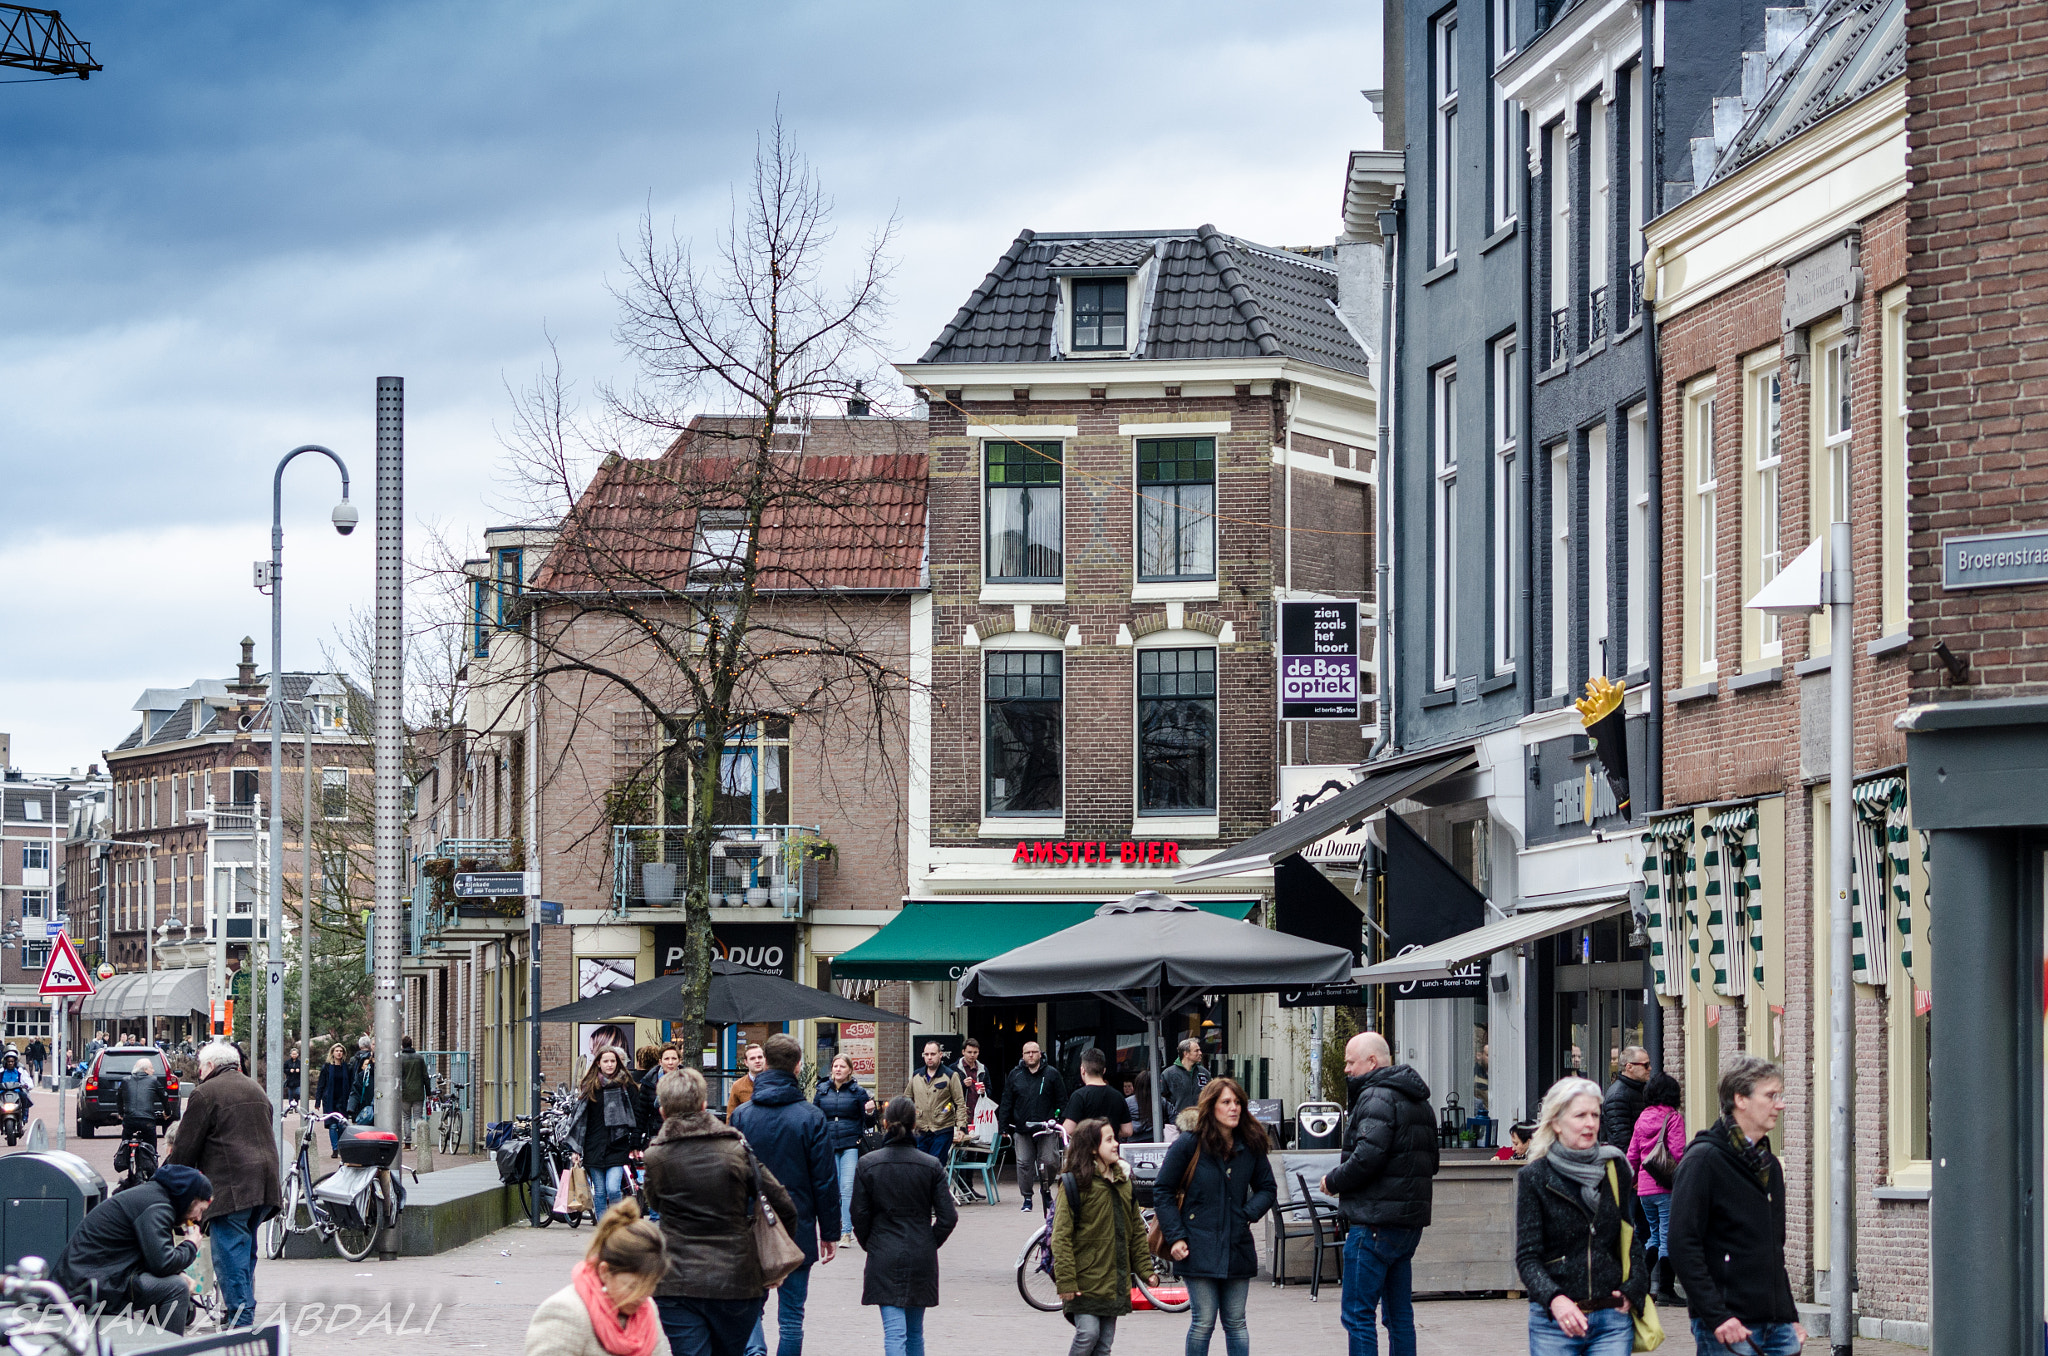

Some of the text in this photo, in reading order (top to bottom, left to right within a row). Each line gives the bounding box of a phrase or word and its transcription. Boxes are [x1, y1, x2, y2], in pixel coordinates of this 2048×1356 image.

[1314, 607, 1340, 618] zien
[1314, 619, 1347, 630] zoals
[1314, 630, 1335, 641] het
[1314, 642, 1349, 653] hoort
[1287, 659, 1351, 676] de Bos
[1288, 677, 1351, 698] optiek
[1012, 841, 1181, 864] AMSTEL BIER
[728, 946, 784, 967] DUO
[846, 1023, 875, 1035] -35%
